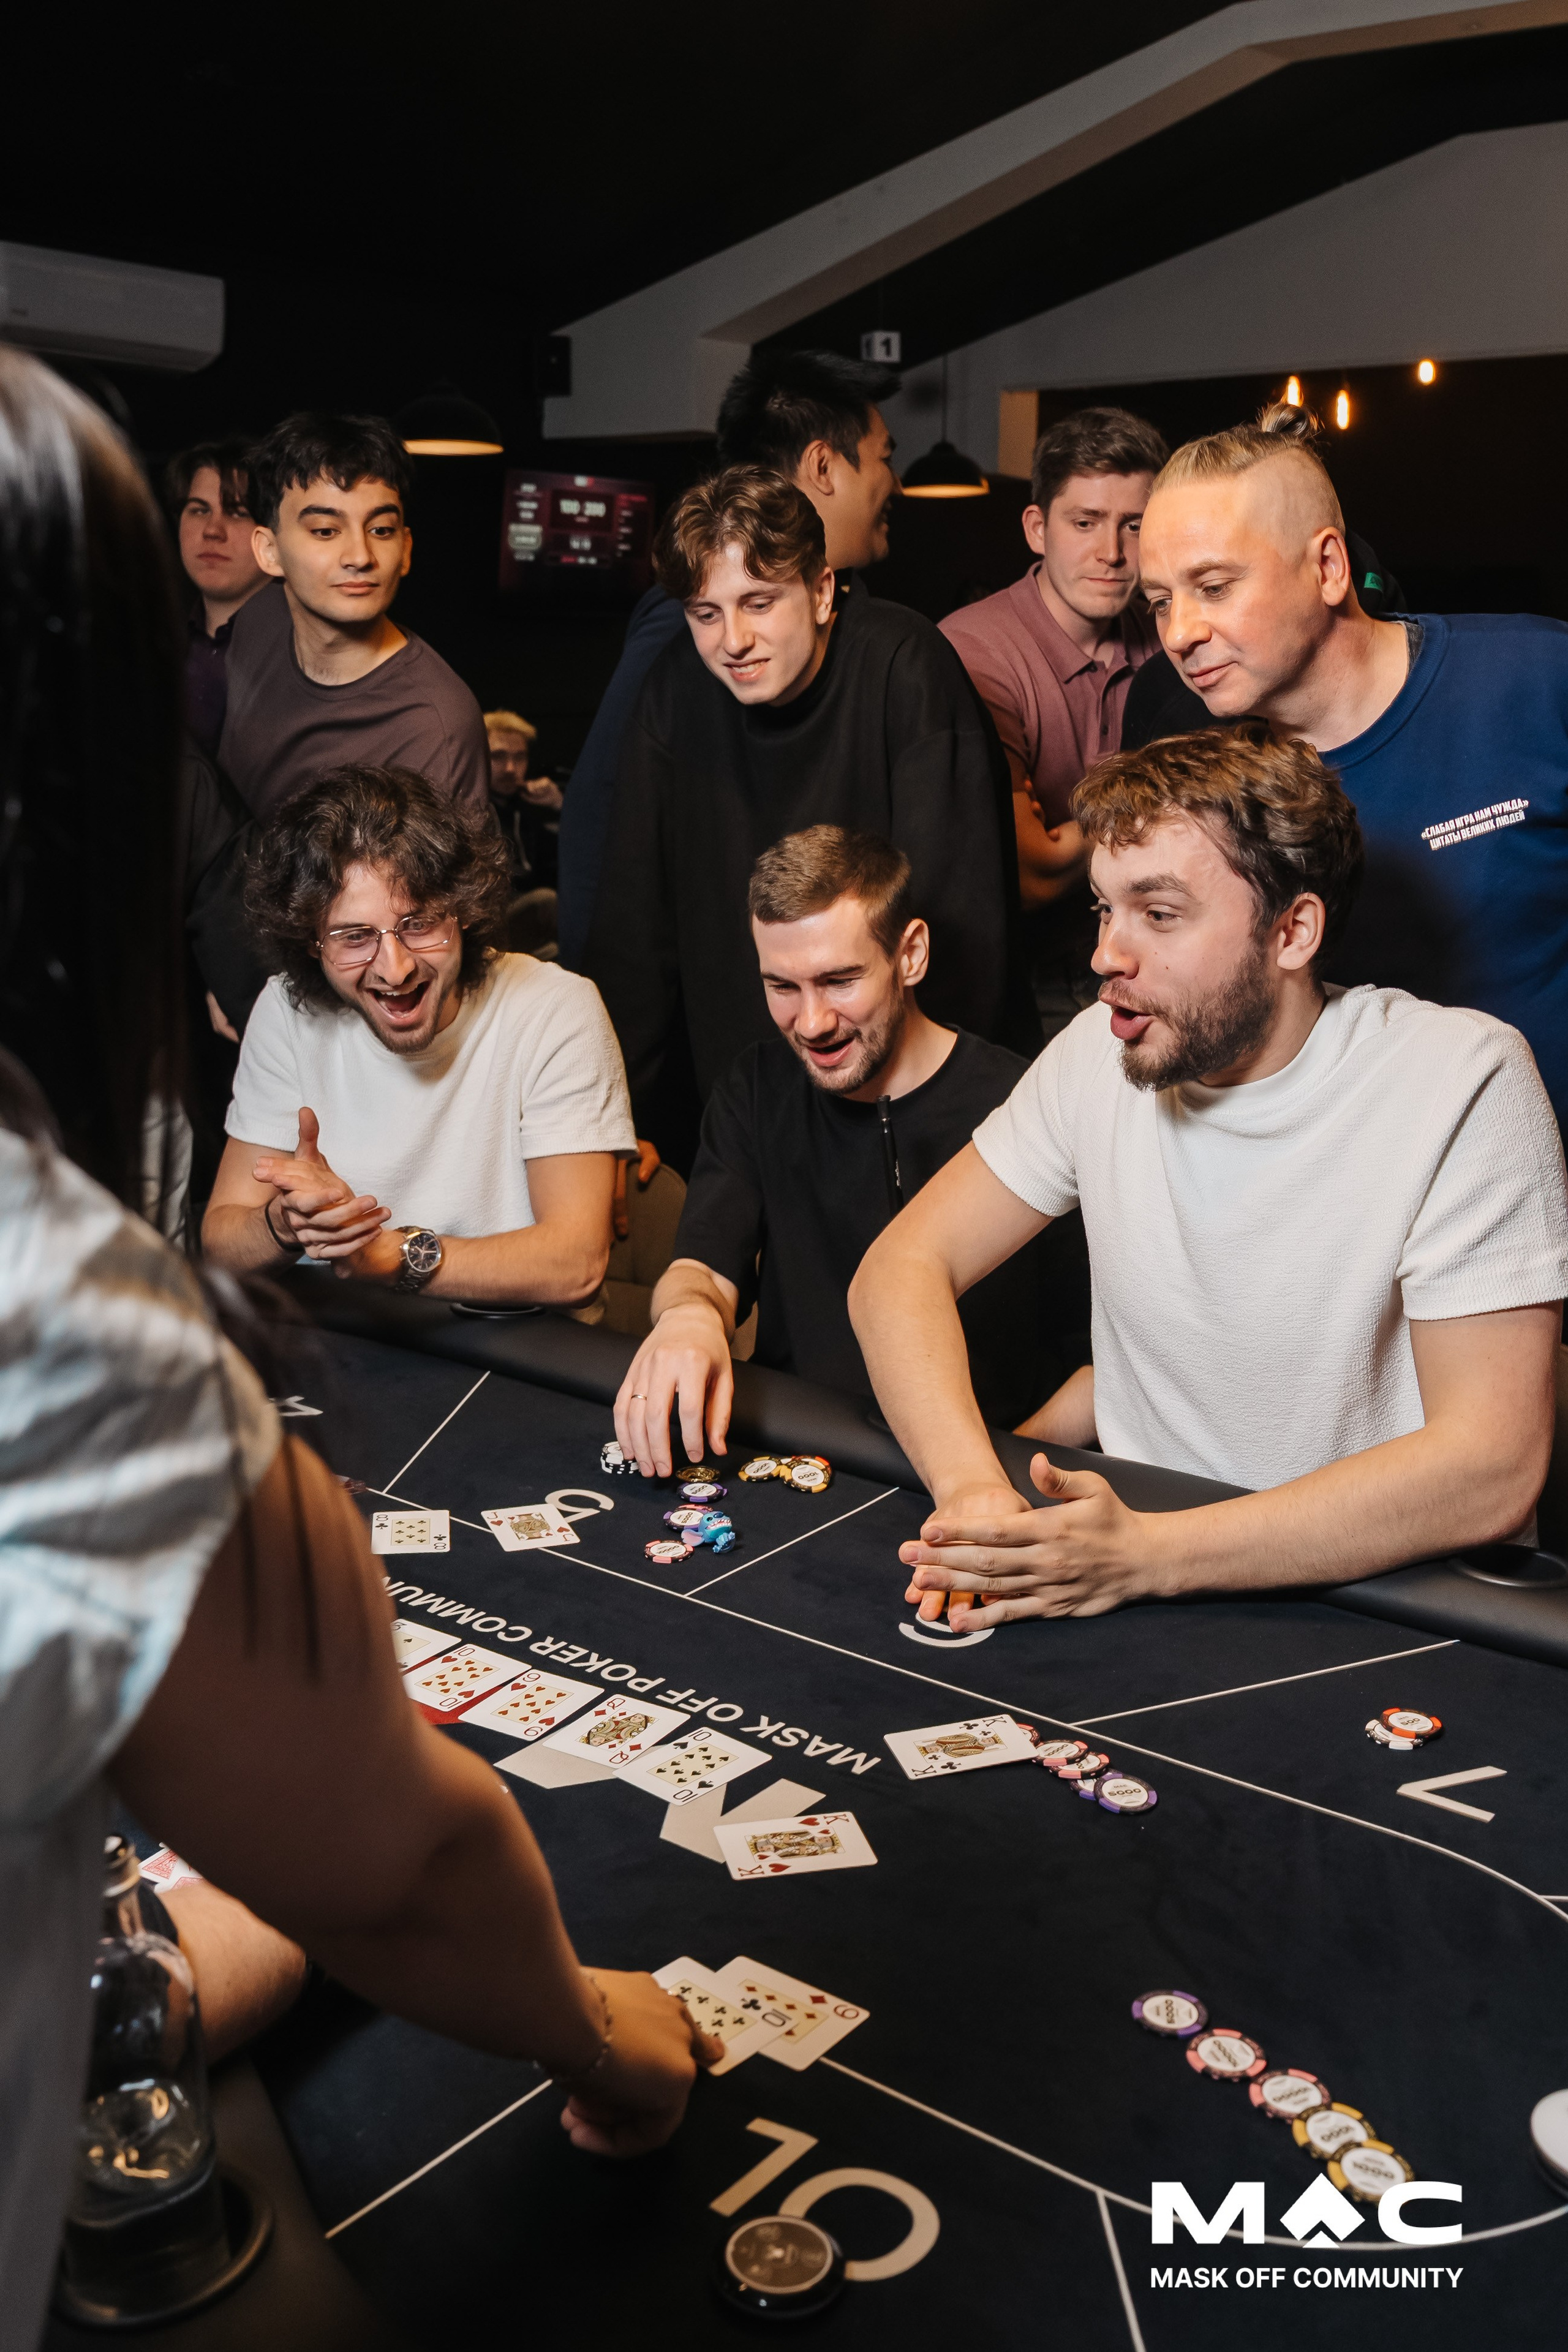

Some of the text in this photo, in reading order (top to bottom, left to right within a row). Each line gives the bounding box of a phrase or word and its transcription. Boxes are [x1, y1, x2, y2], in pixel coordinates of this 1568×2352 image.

[880, 337, 892, 357] 1
[1420, 798, 1529, 840] «СЛАБАЯ ИГРА НАМ ЧУЖДА»
[1429, 809, 1526, 851] ЦИТАТЫ ВЕЛИКИХ ЛЮДЕЙ
[680, 1512, 693, 1524] 5000
[562, 1532, 574, 1542] J
[391, 1621, 407, 1631] 3
[453, 1646, 475, 1657] 10
[529, 1636, 666, 1692] POKER
[522, 1673, 541, 1683] 9
[439, 1697, 462, 1709] 10
[606, 1697, 626, 1710] Q
[655, 1689, 744, 1722] OFF
[982, 1716, 1008, 1727] K
[1400, 1717, 1421, 1726] 500
[523, 1726, 543, 1736] 9
[688, 1729, 712, 1741] 10
[739, 1715, 881, 1774] MASK
[609, 1751, 630, 1764] Q
[911, 1765, 937, 1777] K
[673, 1789, 698, 1803] 10
[1107, 1788, 1142, 1796] 5000
[823, 1813, 850, 1825] K
[737, 1864, 765, 1877] K
[761, 2008, 793, 2027] 10
[709, 2117, 941, 2282] 10
